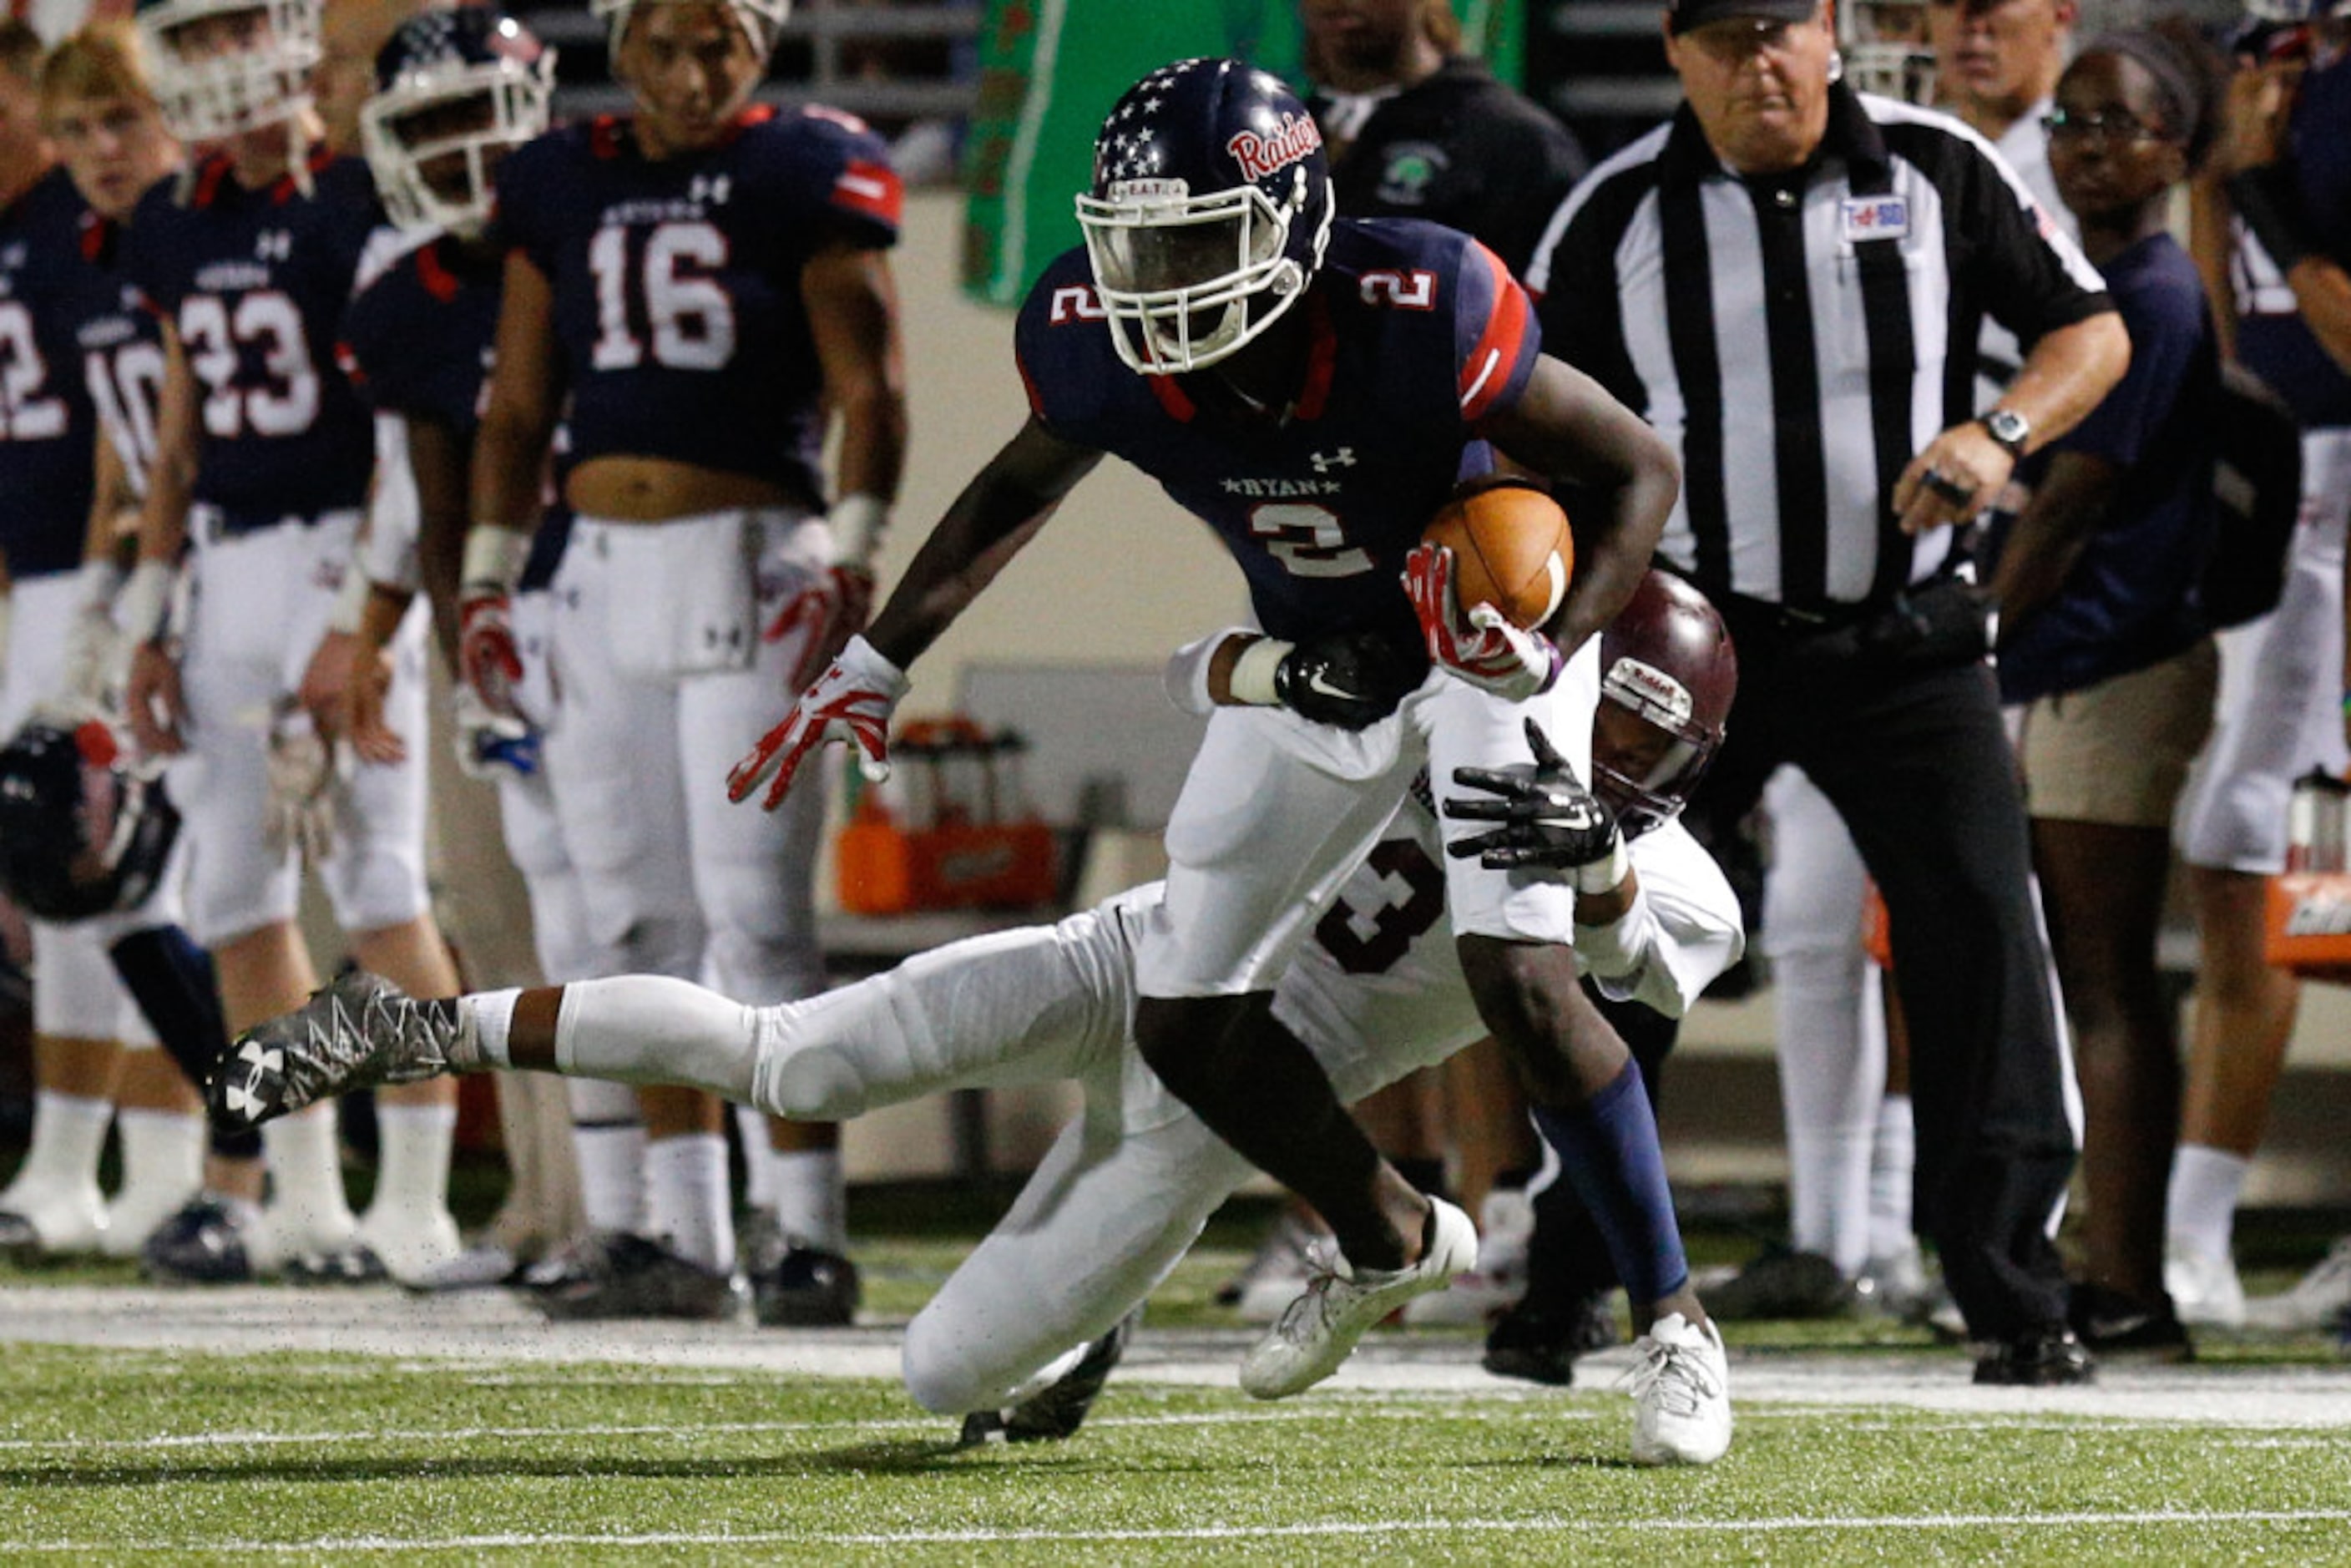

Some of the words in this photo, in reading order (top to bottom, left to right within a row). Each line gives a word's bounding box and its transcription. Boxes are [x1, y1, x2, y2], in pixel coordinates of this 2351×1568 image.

[589, 222, 737, 372] 16
[1049, 283, 1109, 326] 2
[1358, 269, 1438, 311] 2
[0, 301, 68, 440] 2
[1241, 478, 1319, 497] RYAN
[1250, 501, 1376, 578] 2
[1316, 837, 1445, 975] 3
